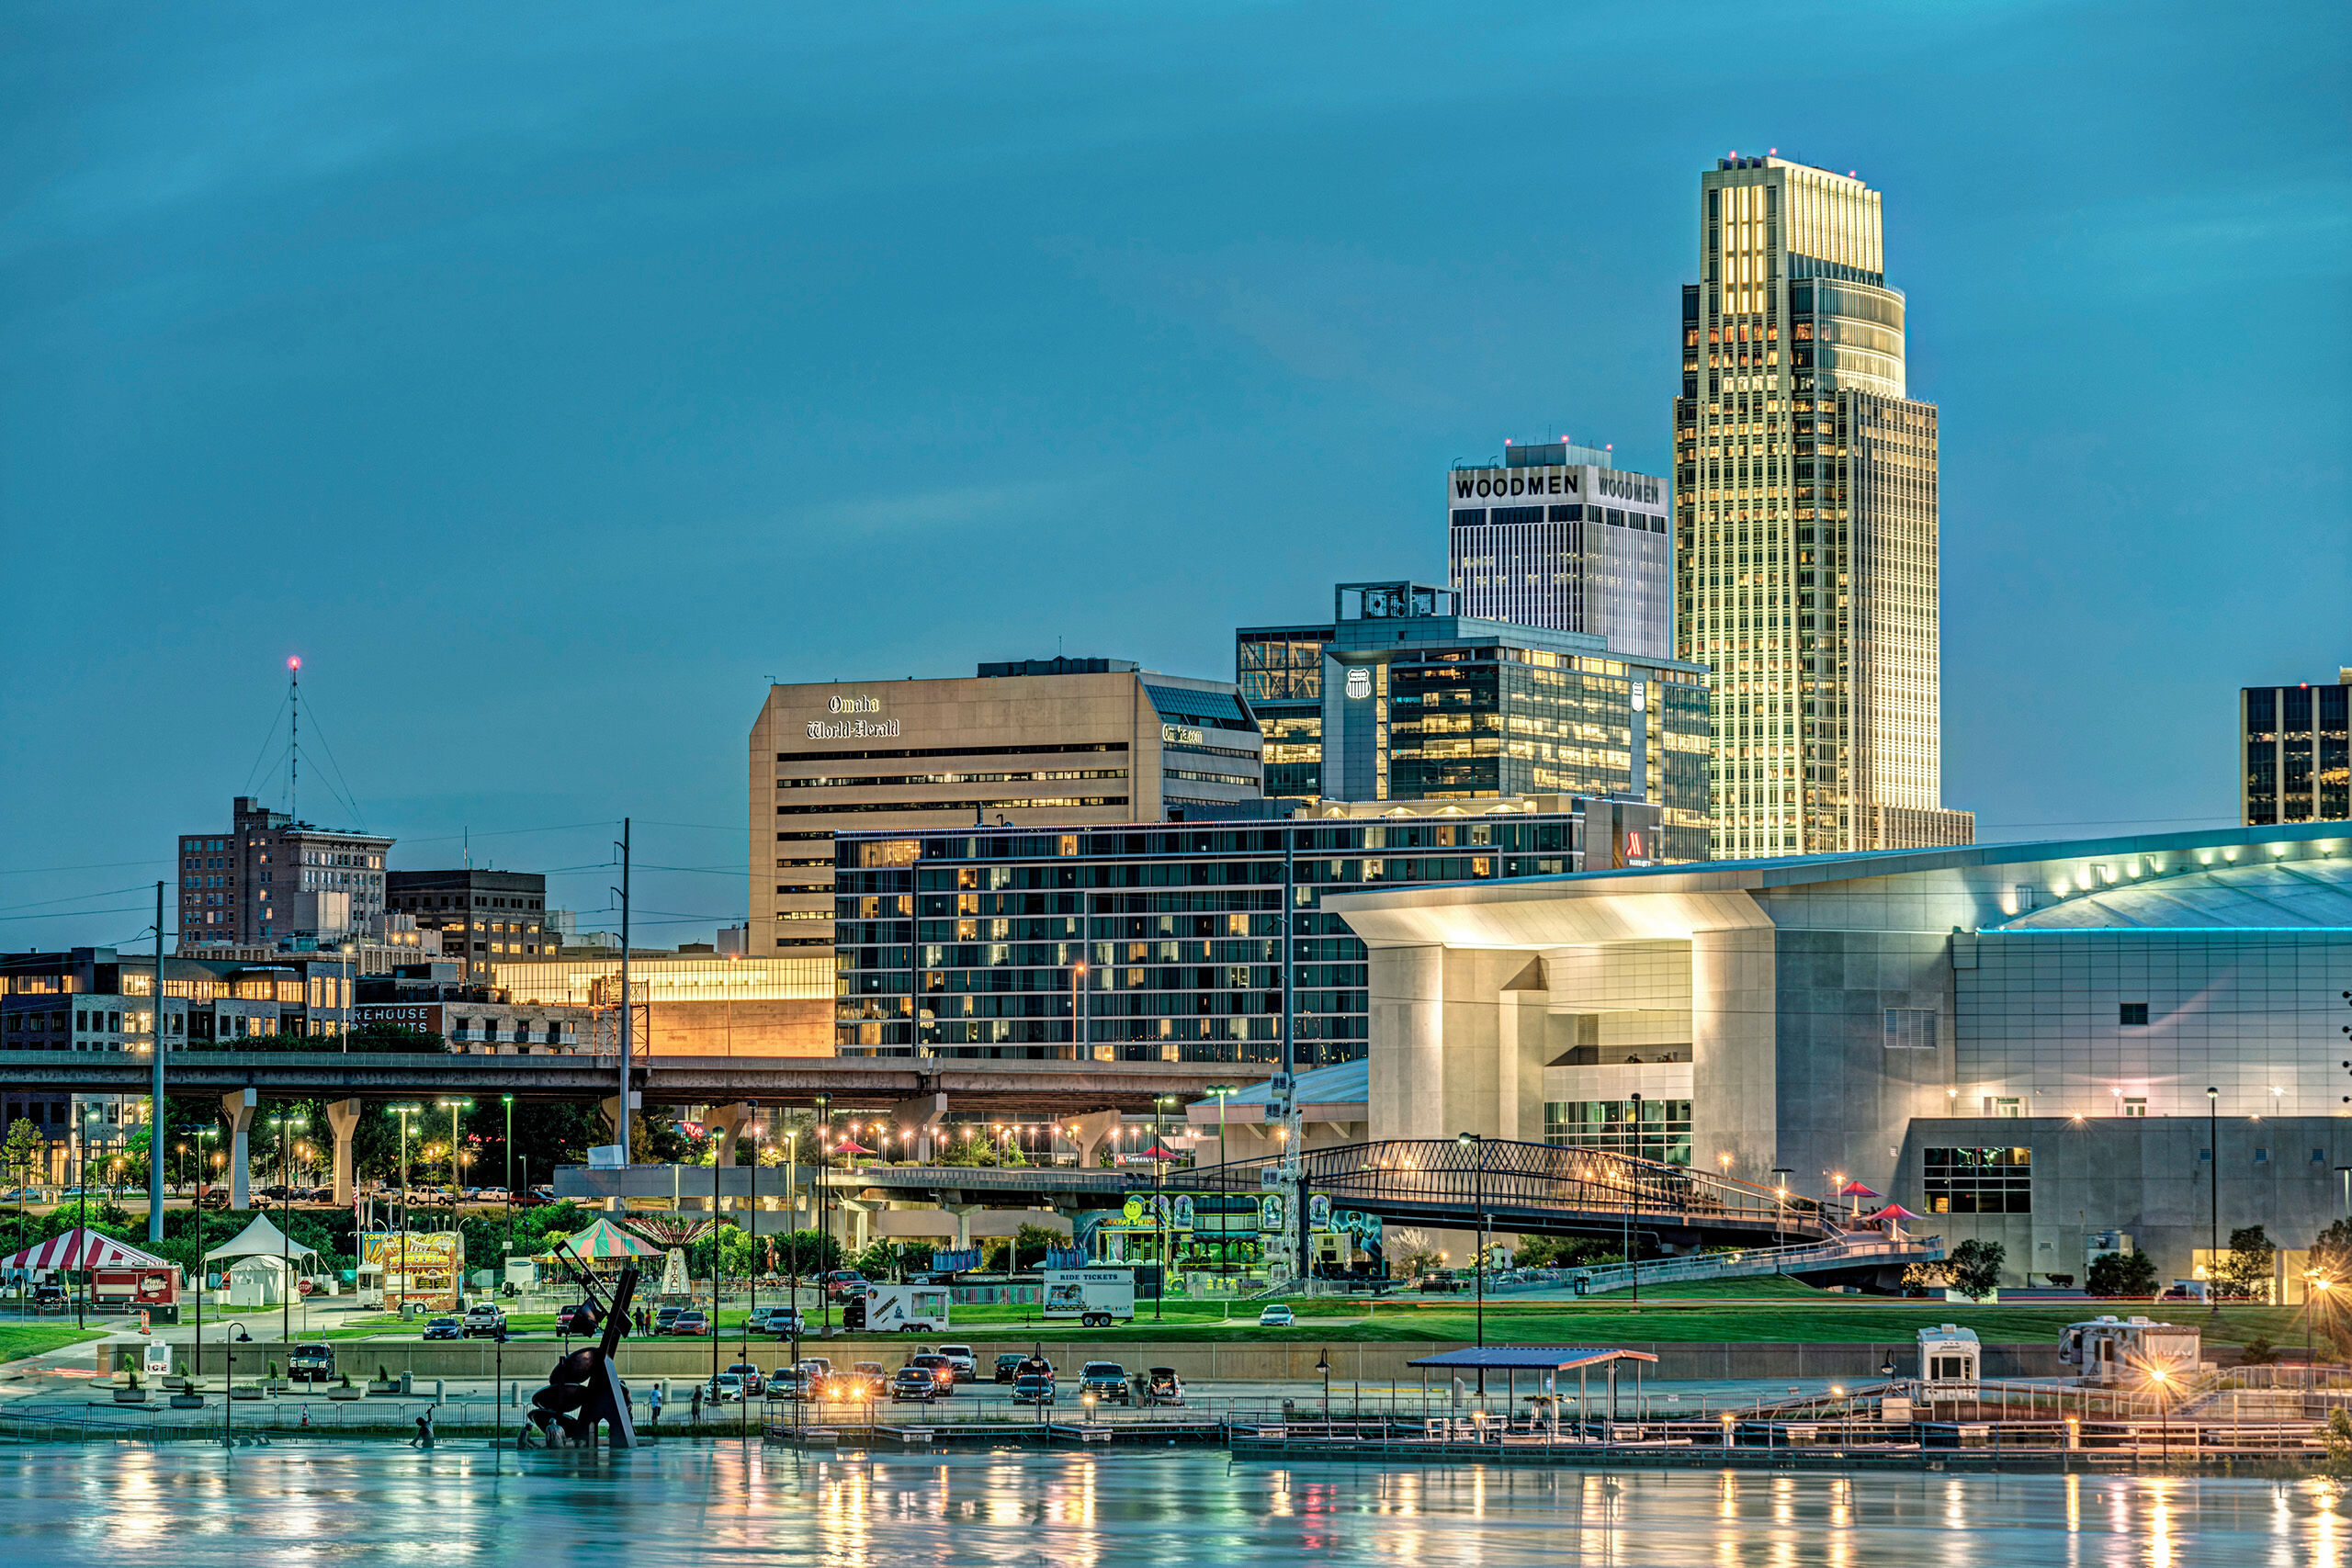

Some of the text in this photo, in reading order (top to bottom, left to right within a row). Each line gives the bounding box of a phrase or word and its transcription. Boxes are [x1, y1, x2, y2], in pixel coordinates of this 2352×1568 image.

[1456, 475, 1578, 499] WOODMEN
[1599, 476, 1659, 504] WOODMEN
[828, 694, 880, 714] Omaha
[807, 719, 900, 739] World-Herald
[390, 1256, 450, 1268] FRIES
